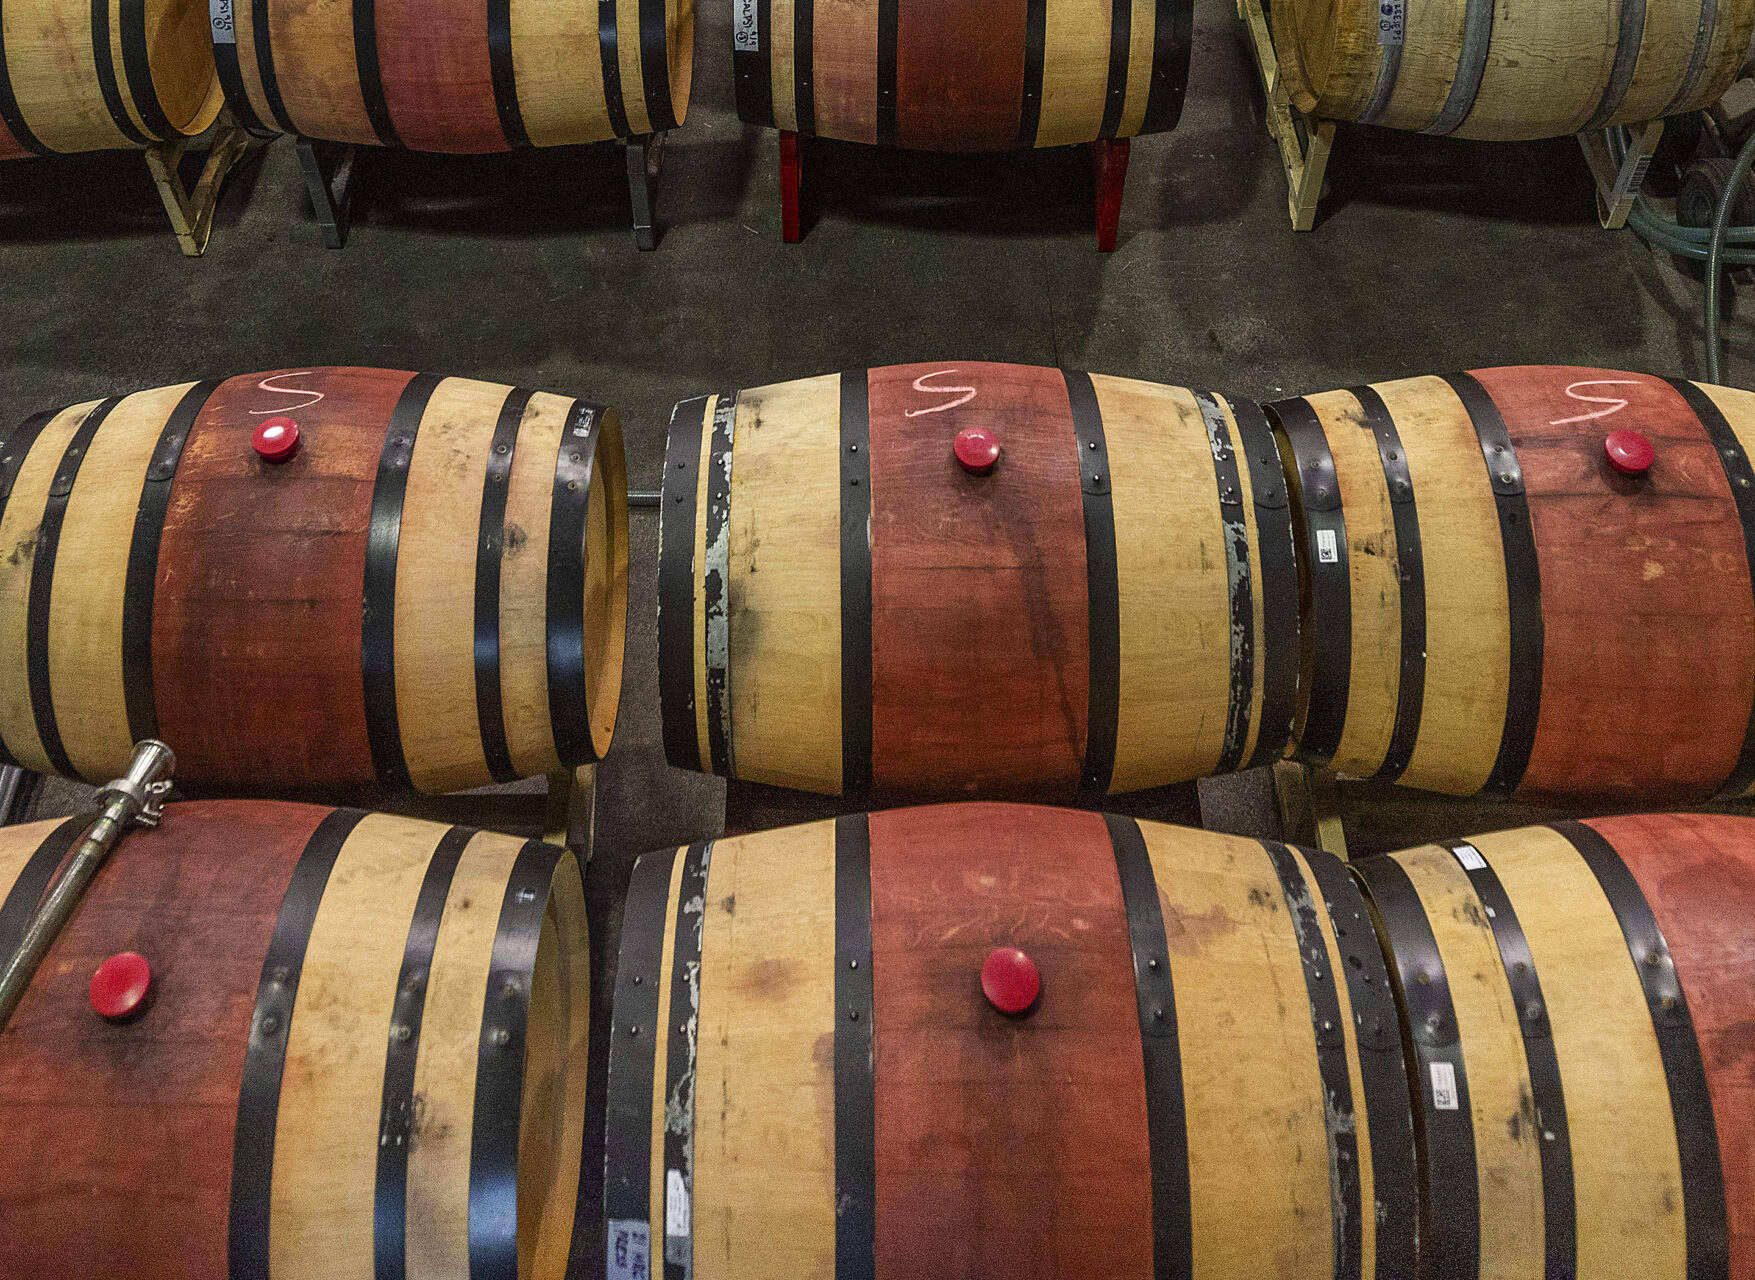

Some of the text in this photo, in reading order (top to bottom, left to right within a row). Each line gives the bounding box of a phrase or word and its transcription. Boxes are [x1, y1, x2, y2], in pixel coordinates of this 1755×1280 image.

[248, 371, 325, 415] S
[905, 369, 978, 417] S
[1549, 380, 1644, 425] S
